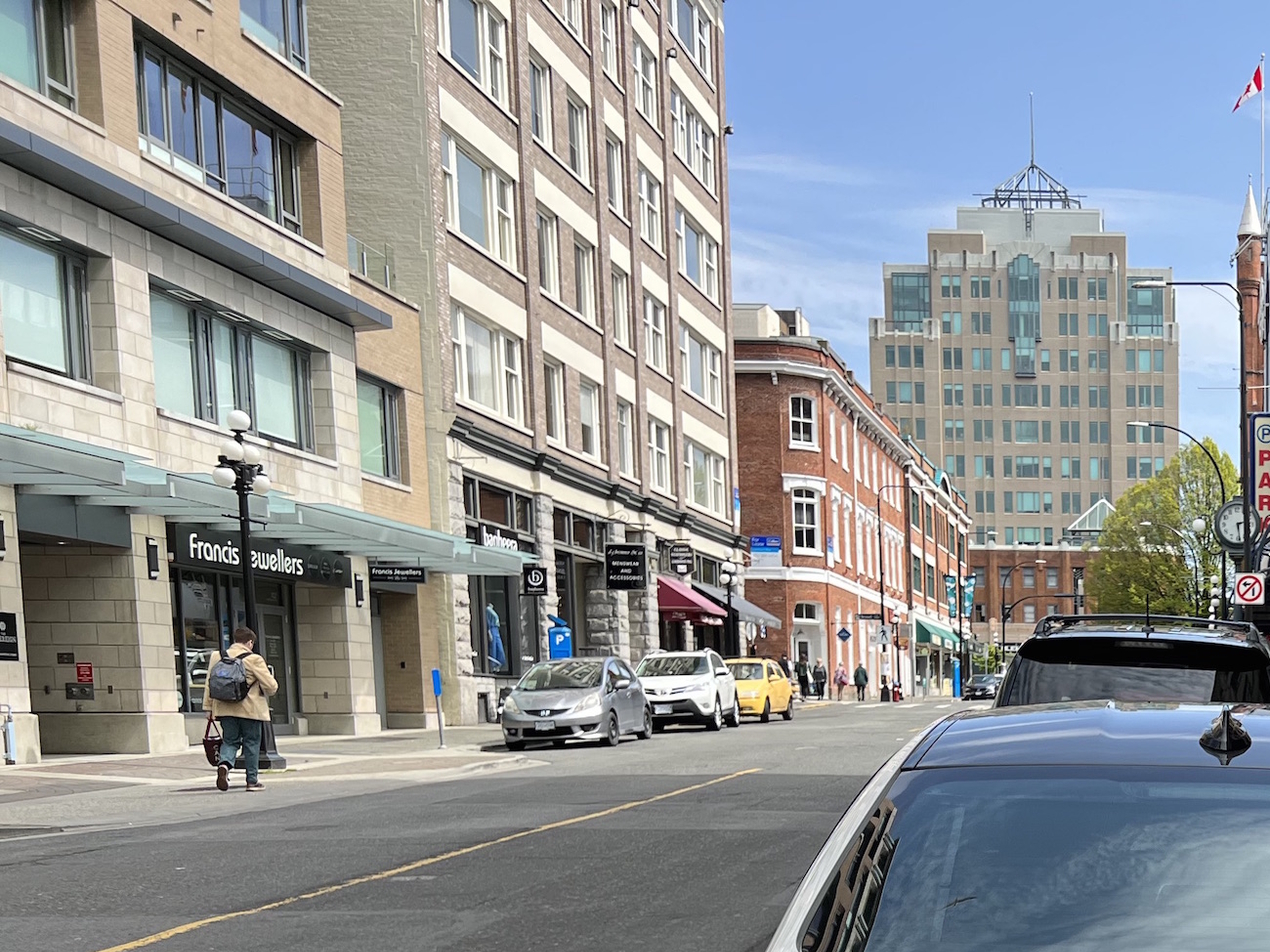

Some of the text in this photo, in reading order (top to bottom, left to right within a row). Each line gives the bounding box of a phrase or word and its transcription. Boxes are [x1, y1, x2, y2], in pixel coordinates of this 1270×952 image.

[188, 532, 304, 576] Francis ewellers
[371, 567, 422, 577] Francis Jewellers
[556, 634, 564, 645] P
